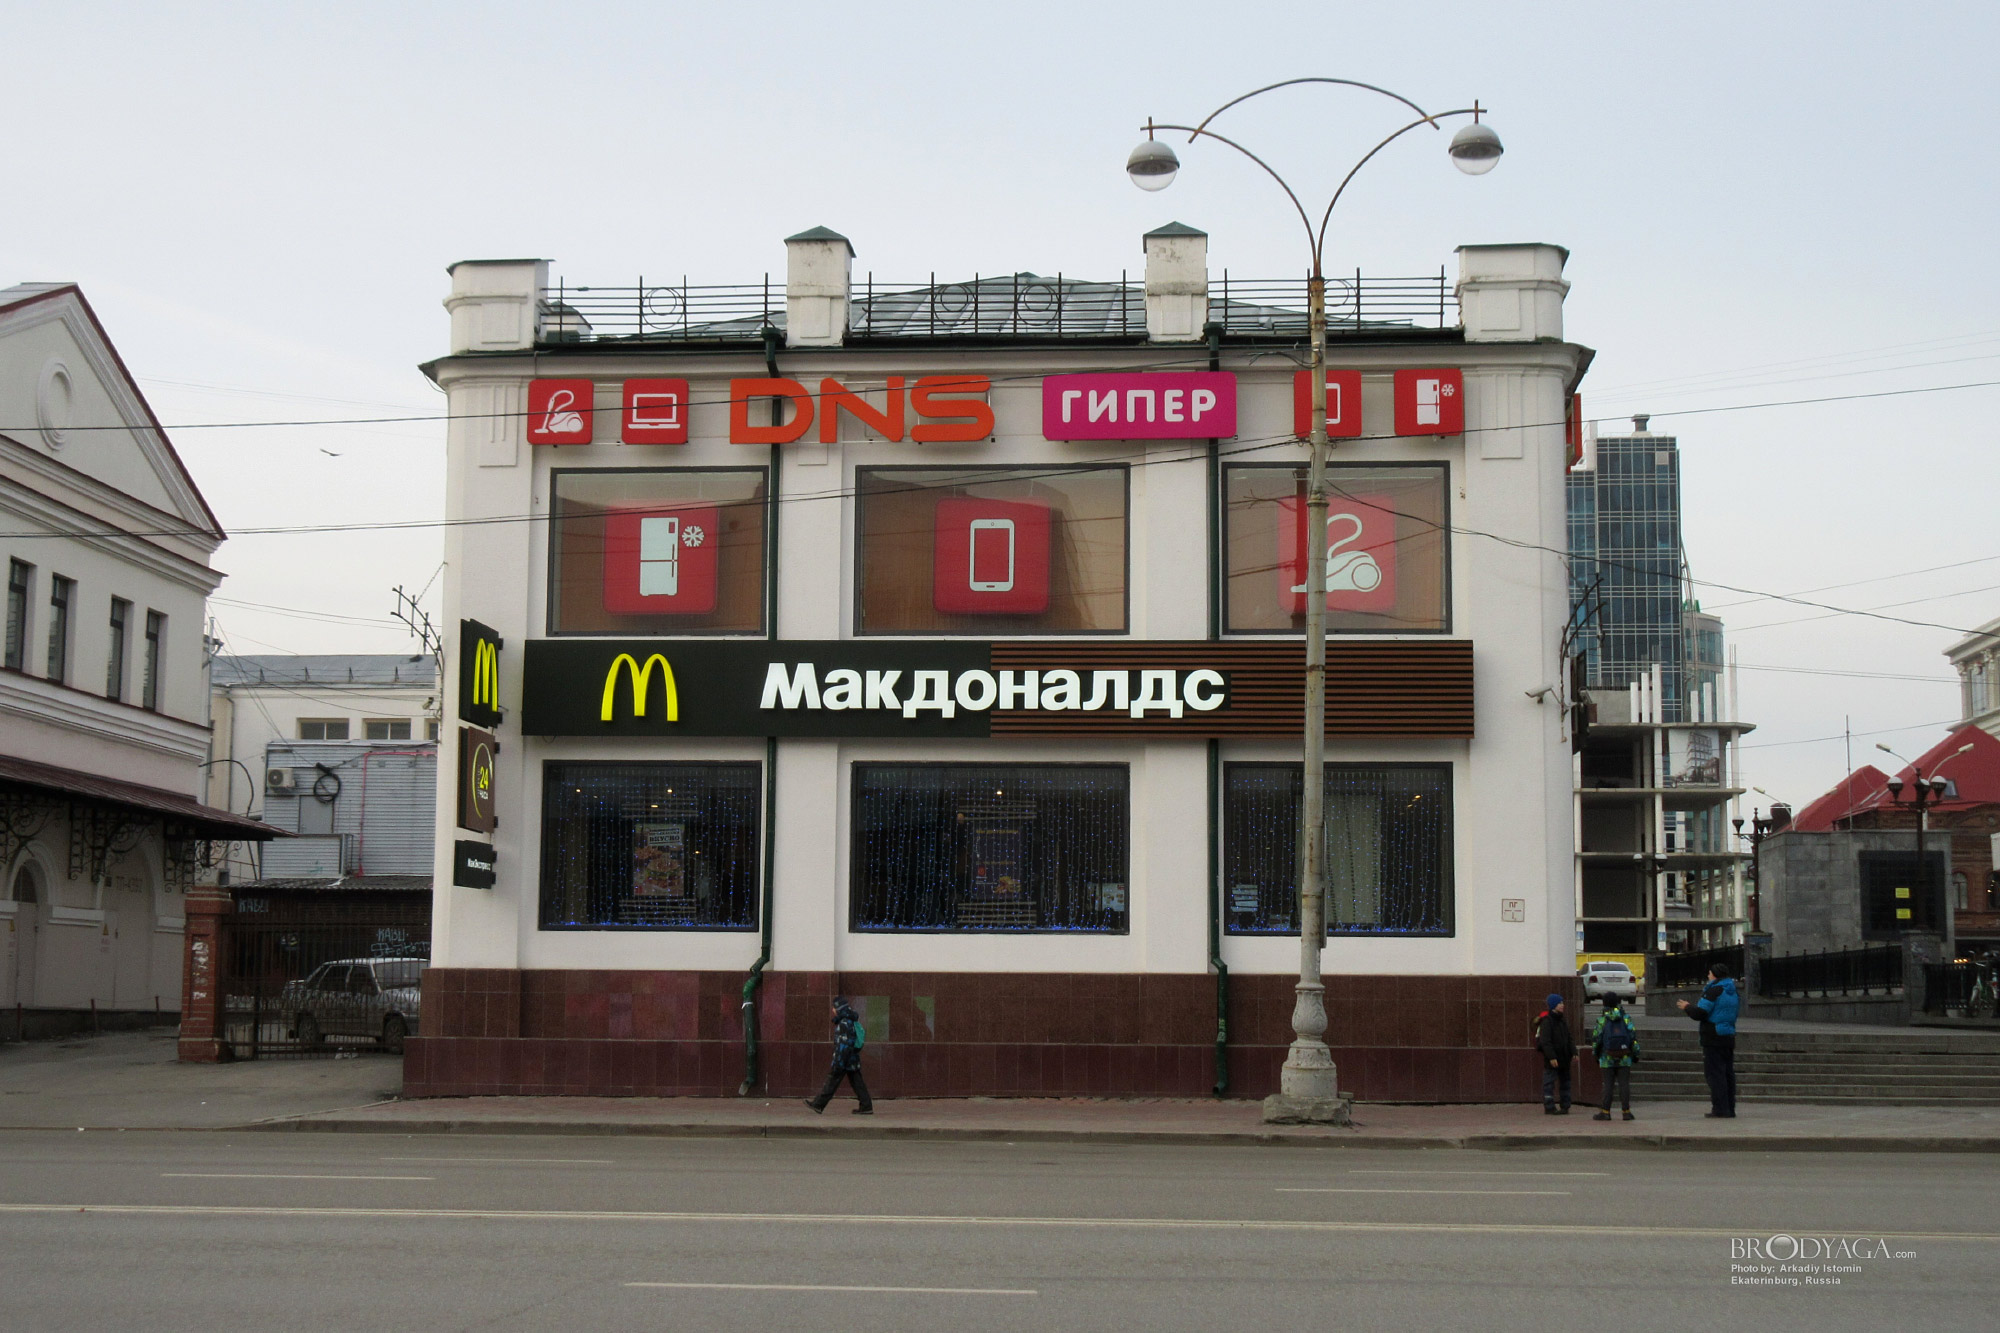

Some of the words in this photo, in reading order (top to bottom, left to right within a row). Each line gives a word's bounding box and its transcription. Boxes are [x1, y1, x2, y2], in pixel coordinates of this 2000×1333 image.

[730, 375, 995, 444] DNS
[1061, 389, 1217, 424] ГИПЕР
[760, 662, 1225, 719] Макдоналдс
[479, 766, 489, 790] 24
